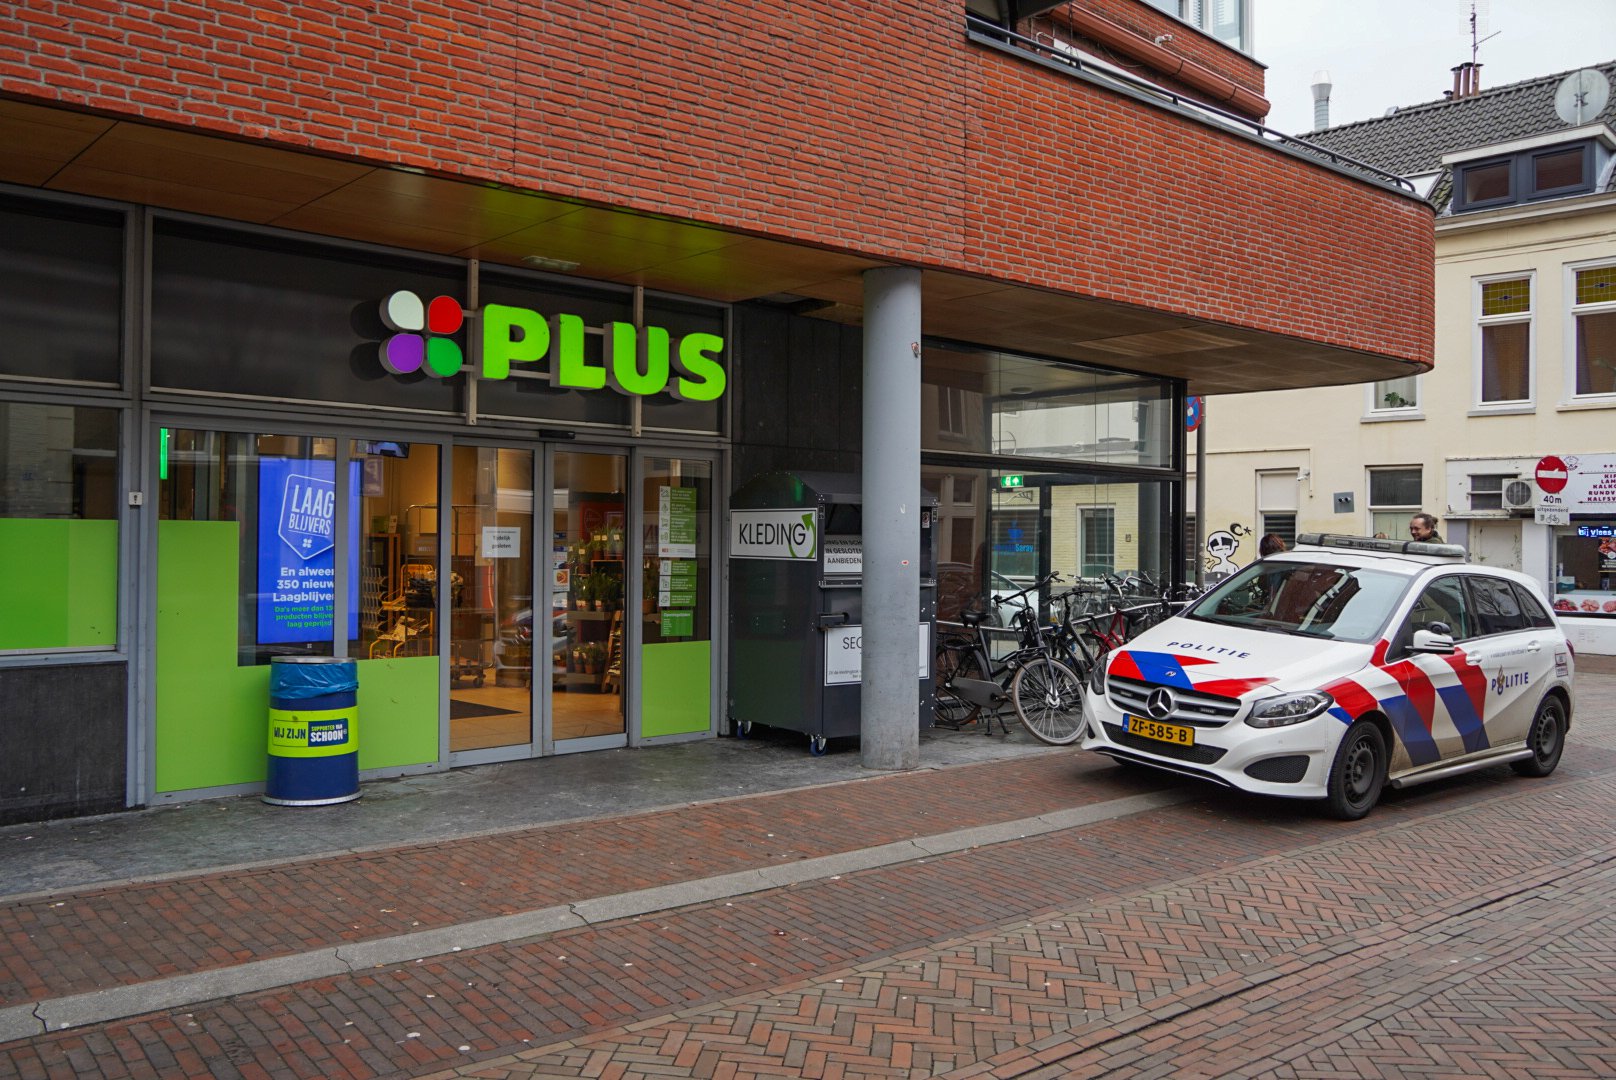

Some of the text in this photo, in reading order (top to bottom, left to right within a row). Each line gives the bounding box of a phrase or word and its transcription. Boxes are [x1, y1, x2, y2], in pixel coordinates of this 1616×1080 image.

[482, 303, 726, 401] PLUS
[291, 484, 335, 519] LAAG
[1543, 495, 1562, 504] 40m
[288, 513, 331, 535] BLIJVERS
[739, 523, 806, 546] KLEDING
[280, 567, 296, 577] En
[277, 579, 300, 590] 350
[1166, 641, 1251, 659] POLITIE
[1491, 671, 1529, 696] POLITIE
[286, 728, 306, 740] ZIJN
[310, 730, 344, 743] SCHOON
[1131, 718, 1187, 743] ZF-585-B
